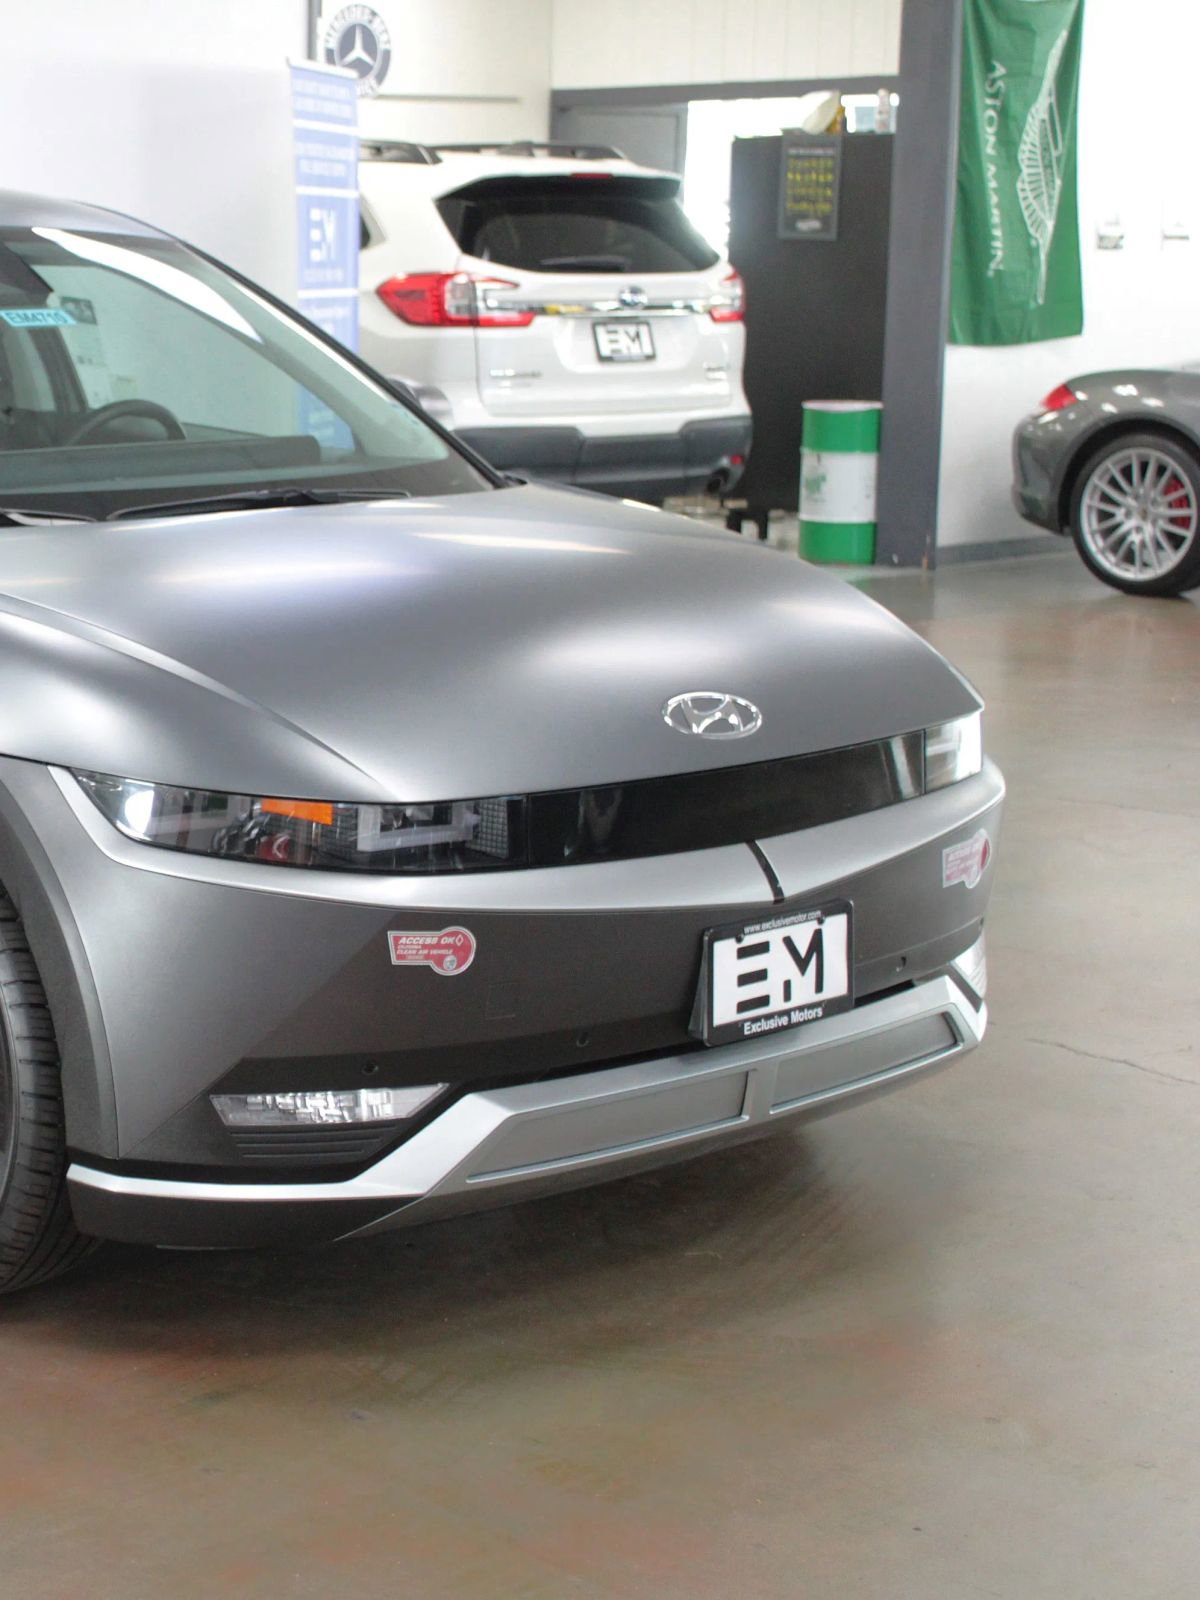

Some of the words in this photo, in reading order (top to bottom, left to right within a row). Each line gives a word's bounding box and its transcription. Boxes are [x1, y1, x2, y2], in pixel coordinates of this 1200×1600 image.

[984, 60, 1007, 156] ASTON
[743, 910, 821, 934] www.exclusivemotor.com
[736, 928, 824, 1014] EM
[743, 1014, 788, 1035] Exclusive
[790, 1006, 823, 1025] Motors
